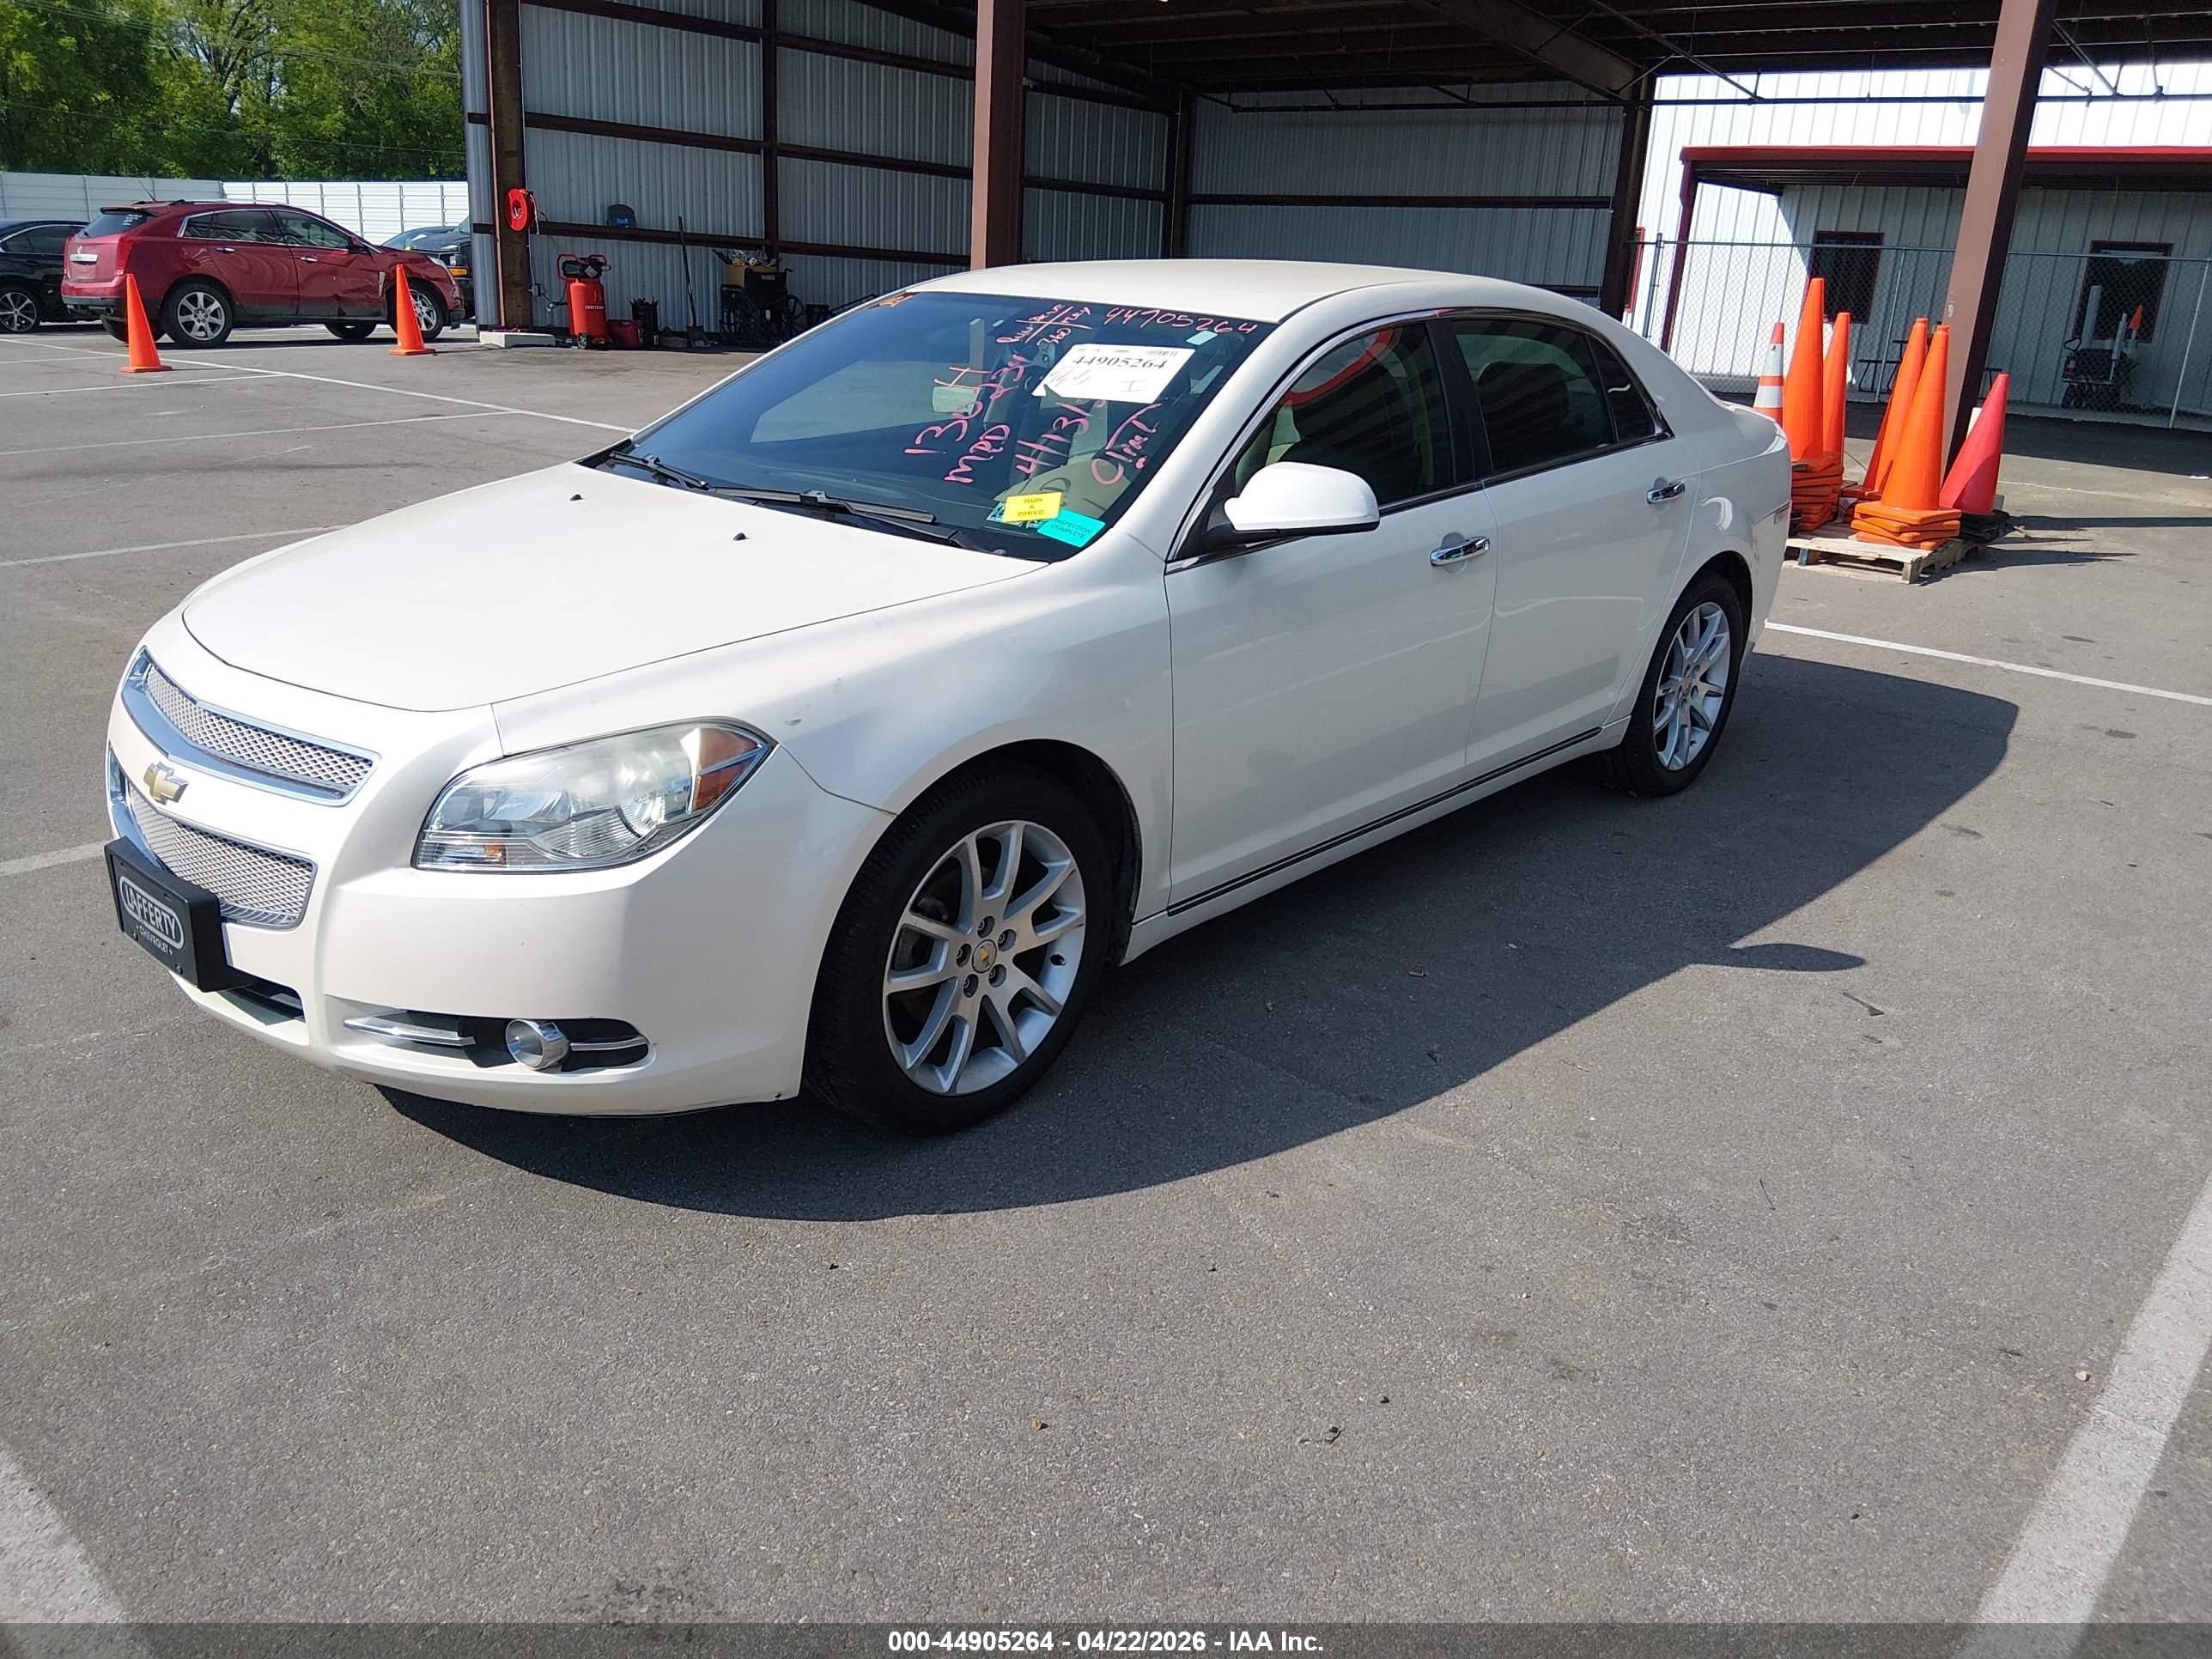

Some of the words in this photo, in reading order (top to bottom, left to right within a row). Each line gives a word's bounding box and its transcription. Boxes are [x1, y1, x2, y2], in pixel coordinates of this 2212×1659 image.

[1073, 356, 1168, 369] 44905264
[944, 424, 1011, 483] MPD
[125, 884, 175, 939] LAFFERTY
[139, 926, 169, 955] CHEVROLET
